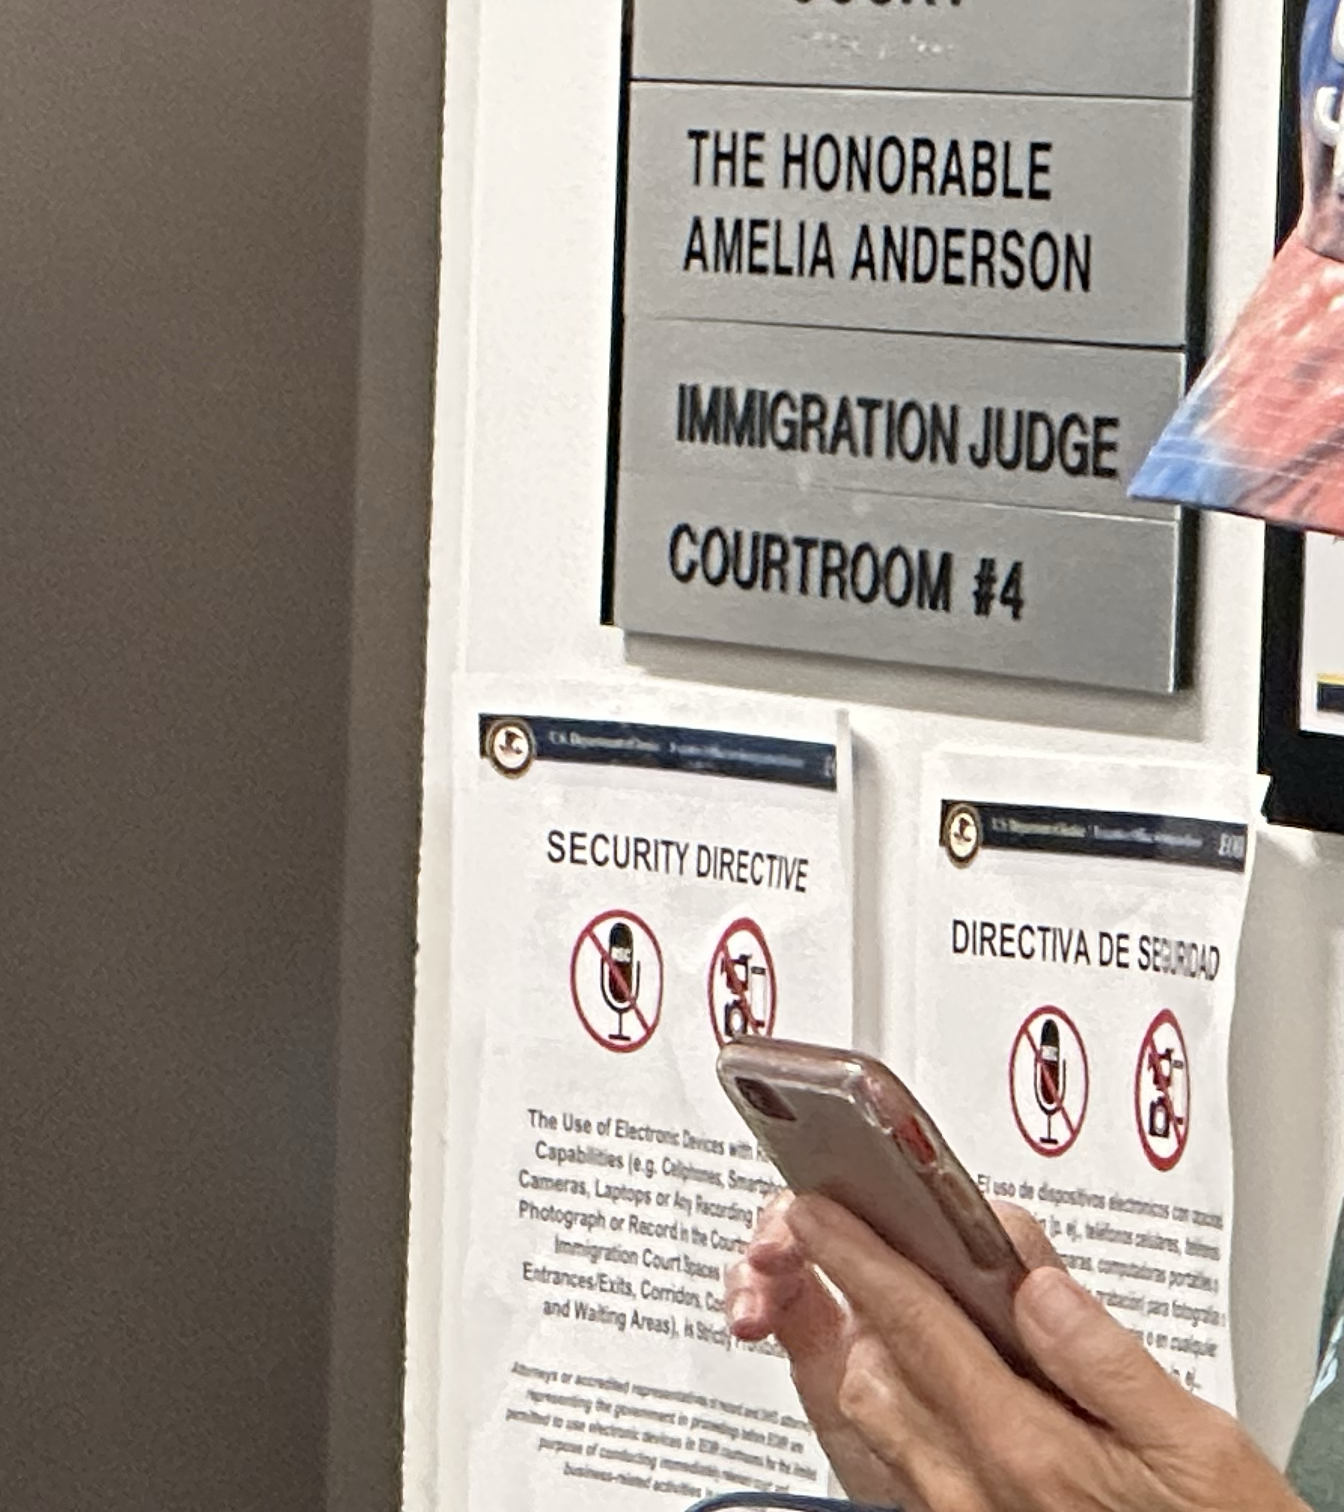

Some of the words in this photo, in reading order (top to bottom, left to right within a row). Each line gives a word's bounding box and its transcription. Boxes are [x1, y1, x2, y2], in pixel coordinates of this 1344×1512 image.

[687, 129, 765, 190] THE
[782, 133, 1053, 201] HONORABLE
[683, 217, 834, 279] AMELIA
[852, 225, 1092, 293] ANDERSON
[677, 382, 960, 465] IMMIGRATION
[969, 405, 1121, 480] JUDGE
[668, 522, 952, 614] COURTROOM
[972, 557, 1027, 622] #4
[546, 829, 690, 877] SECURITY
[696, 843, 810, 893] DIRECTIVE
[951, 919, 1091, 966] DIRECTIVA
[1099, 933, 1130, 969] DE
[528, 1109, 557, 1130] The
[562, 1112, 592, 1134] Use
[597, 1117, 612, 1136] of
[518, 1168, 591, 1199] Cameras,
[595, 1178, 652, 1207] Laptops
[656, 1192, 671, 1207] or
[519, 1199, 606, 1233] Photograph
[610, 1216, 625, 1231] or
[628, 1214, 677, 1241] Record
[642, 1247, 681, 1272] Court
[543, 1299, 571, 1319] and
[574, 1300, 626, 1332] Waiting
